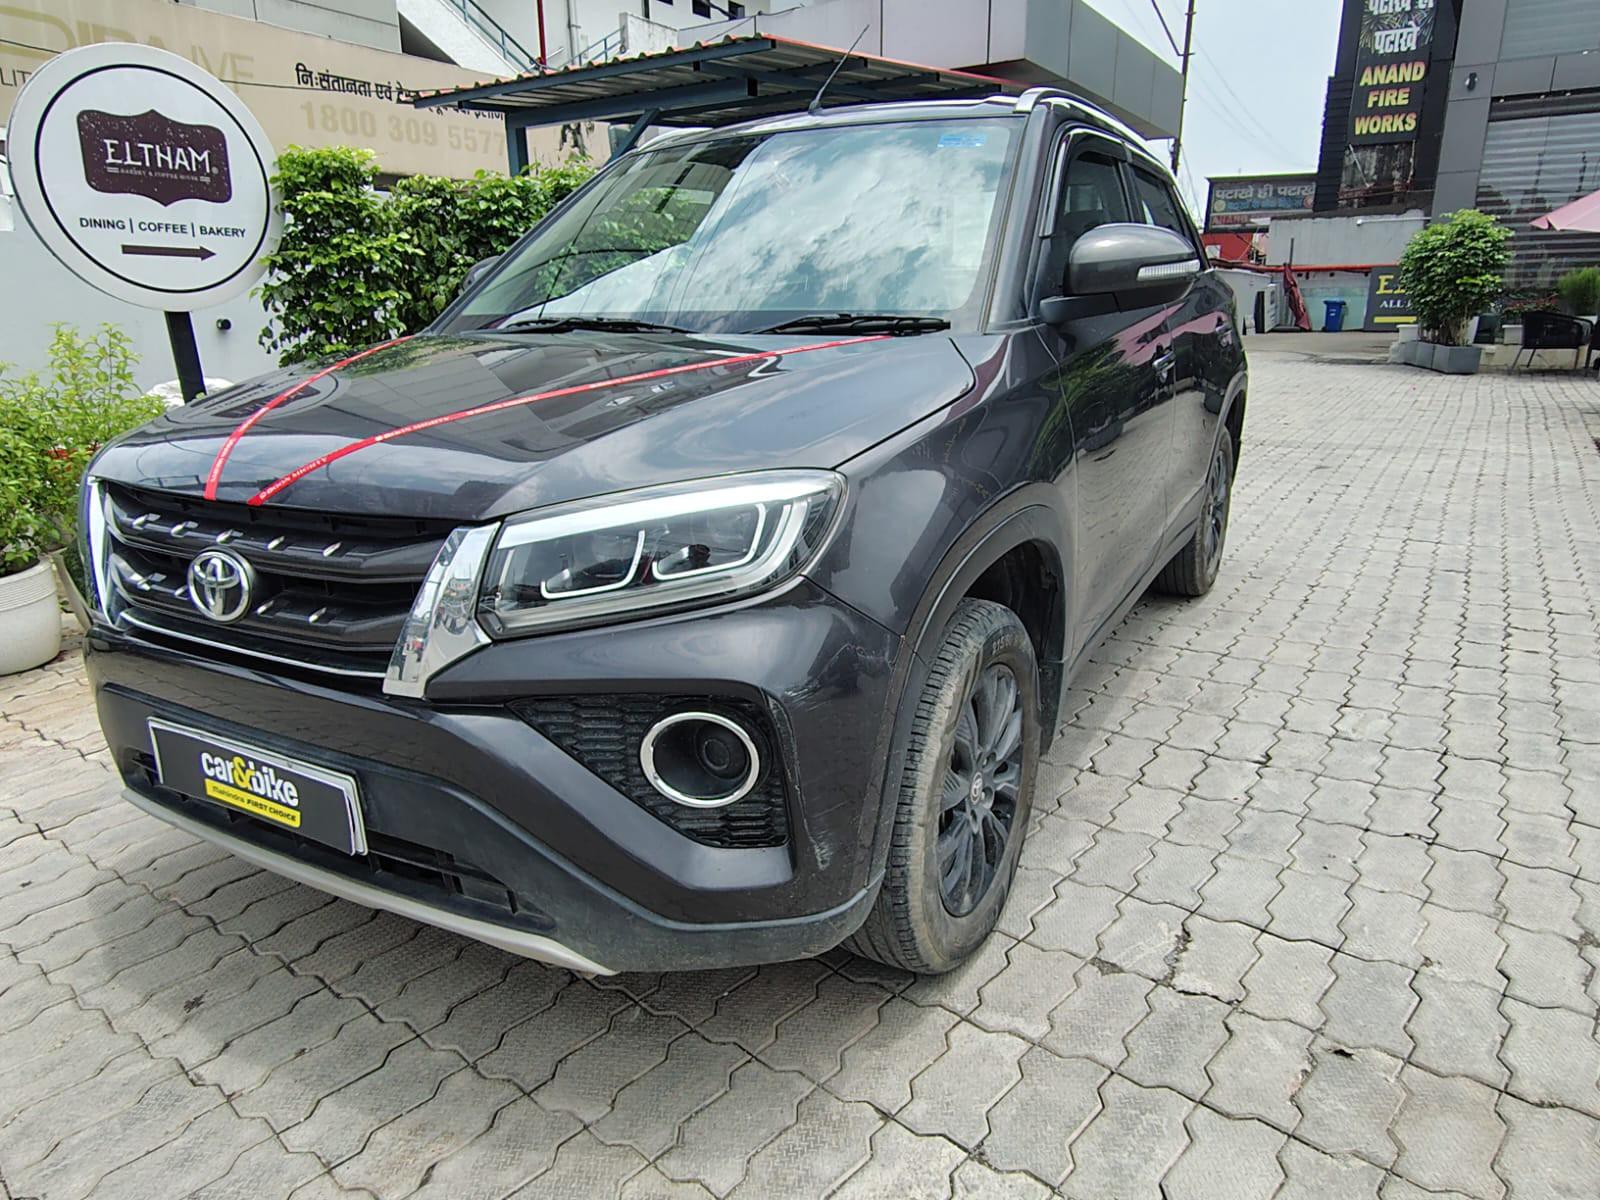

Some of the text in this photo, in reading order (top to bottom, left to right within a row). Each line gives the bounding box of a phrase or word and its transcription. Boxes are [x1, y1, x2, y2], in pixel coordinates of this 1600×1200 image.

[1374, 20, 1420, 54] पटाखे
[1360, 61, 1426, 86] ANAND
[1367, 87, 1411, 108] FIRE
[300, 101, 376, 138] 1800
[387, 114, 439, 146] 309
[1354, 112, 1417, 135] WORKS
[103, 138, 211, 174] ELTHAM
[79, 217, 247, 238] DINING COFFEE BAKERY
[201, 751, 299, 807] car&bike
[246, 798, 268, 811] FIRST
